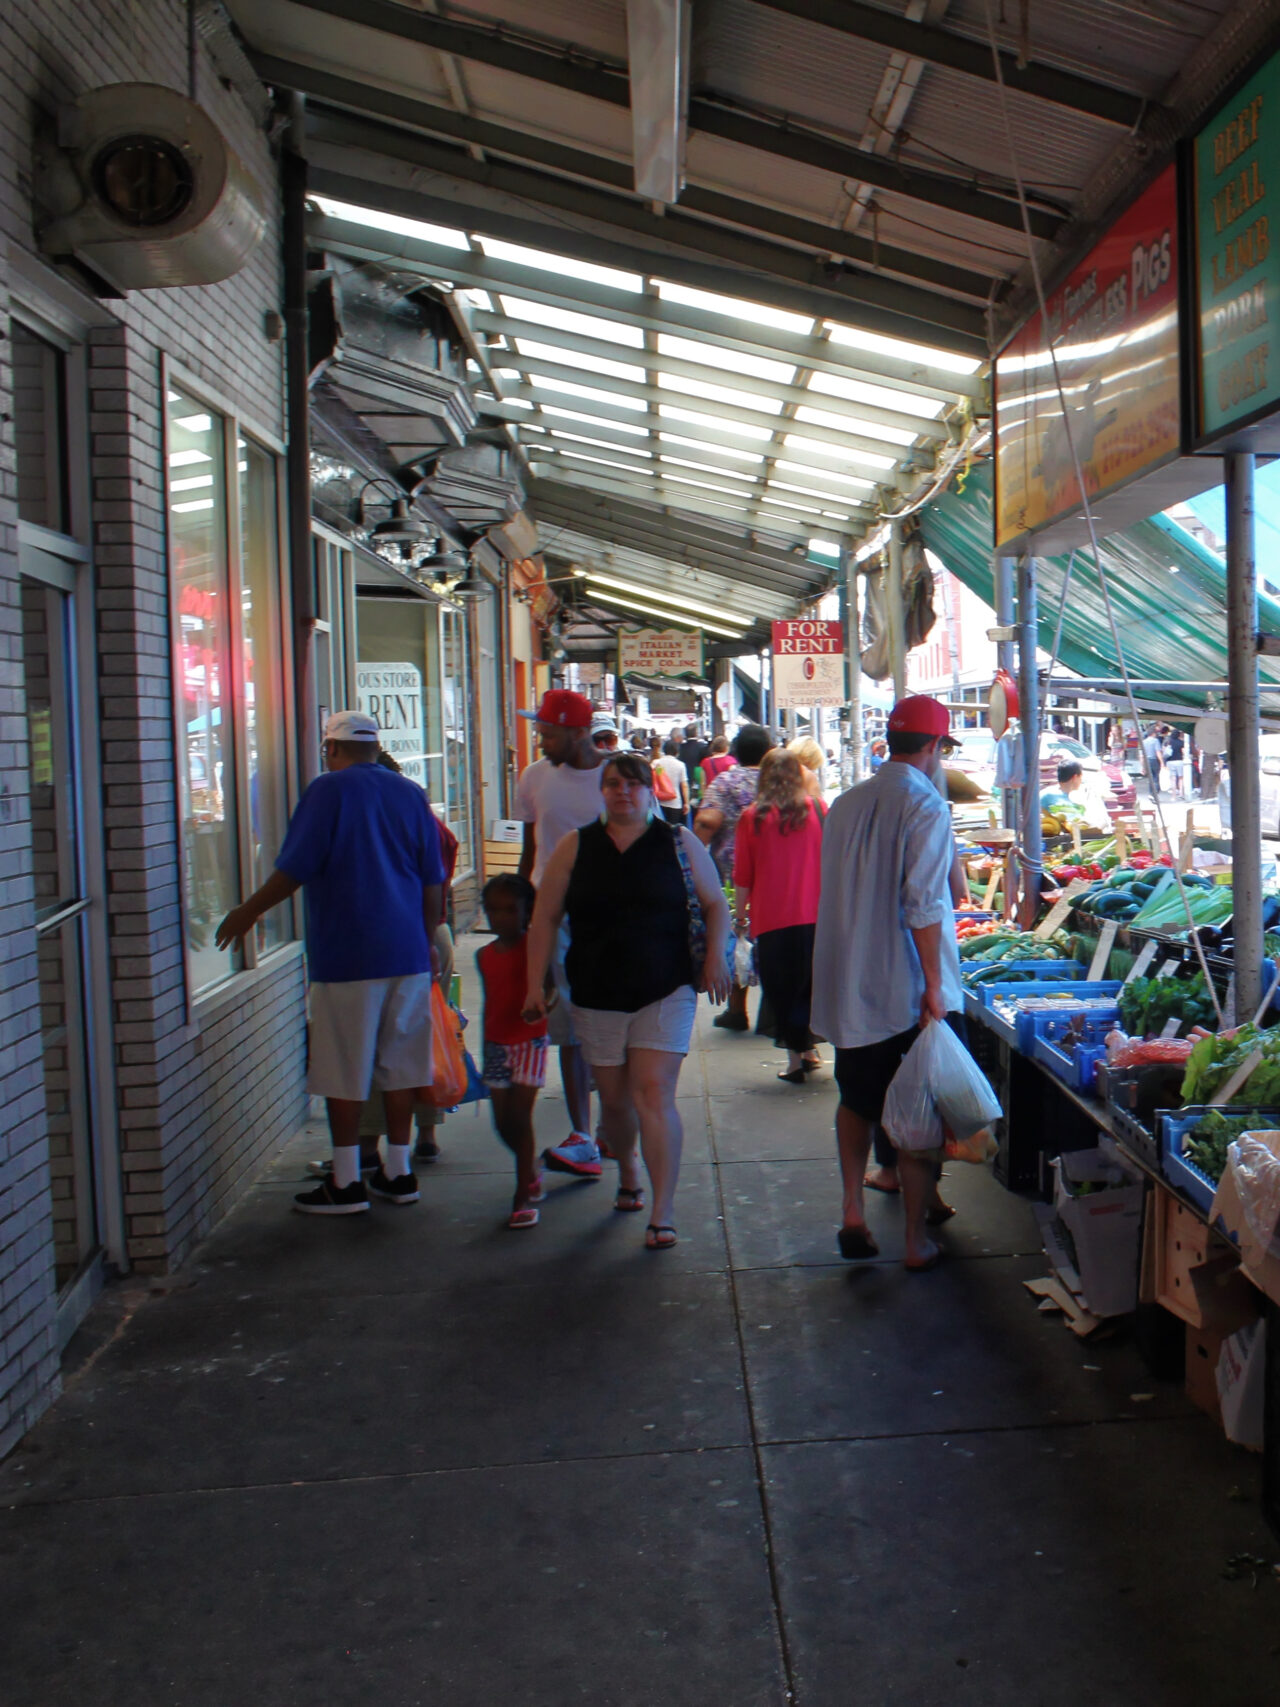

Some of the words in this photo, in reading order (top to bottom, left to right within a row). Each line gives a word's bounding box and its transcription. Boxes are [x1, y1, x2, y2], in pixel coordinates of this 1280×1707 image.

[1213, 95, 1263, 178] BEEF
[1212, 161, 1265, 235] VEAL
[1212, 215, 1270, 297] LAMB
[1218, 341, 1269, 412] GOAT
[786, 621, 831, 637] FOR
[639, 650, 683, 658] MARKET
[640, 641, 682, 649] ITALIAN
[779, 638, 838, 653] RENT
[383, 672, 419, 688] STORE
[368, 694, 419, 730] RENT
